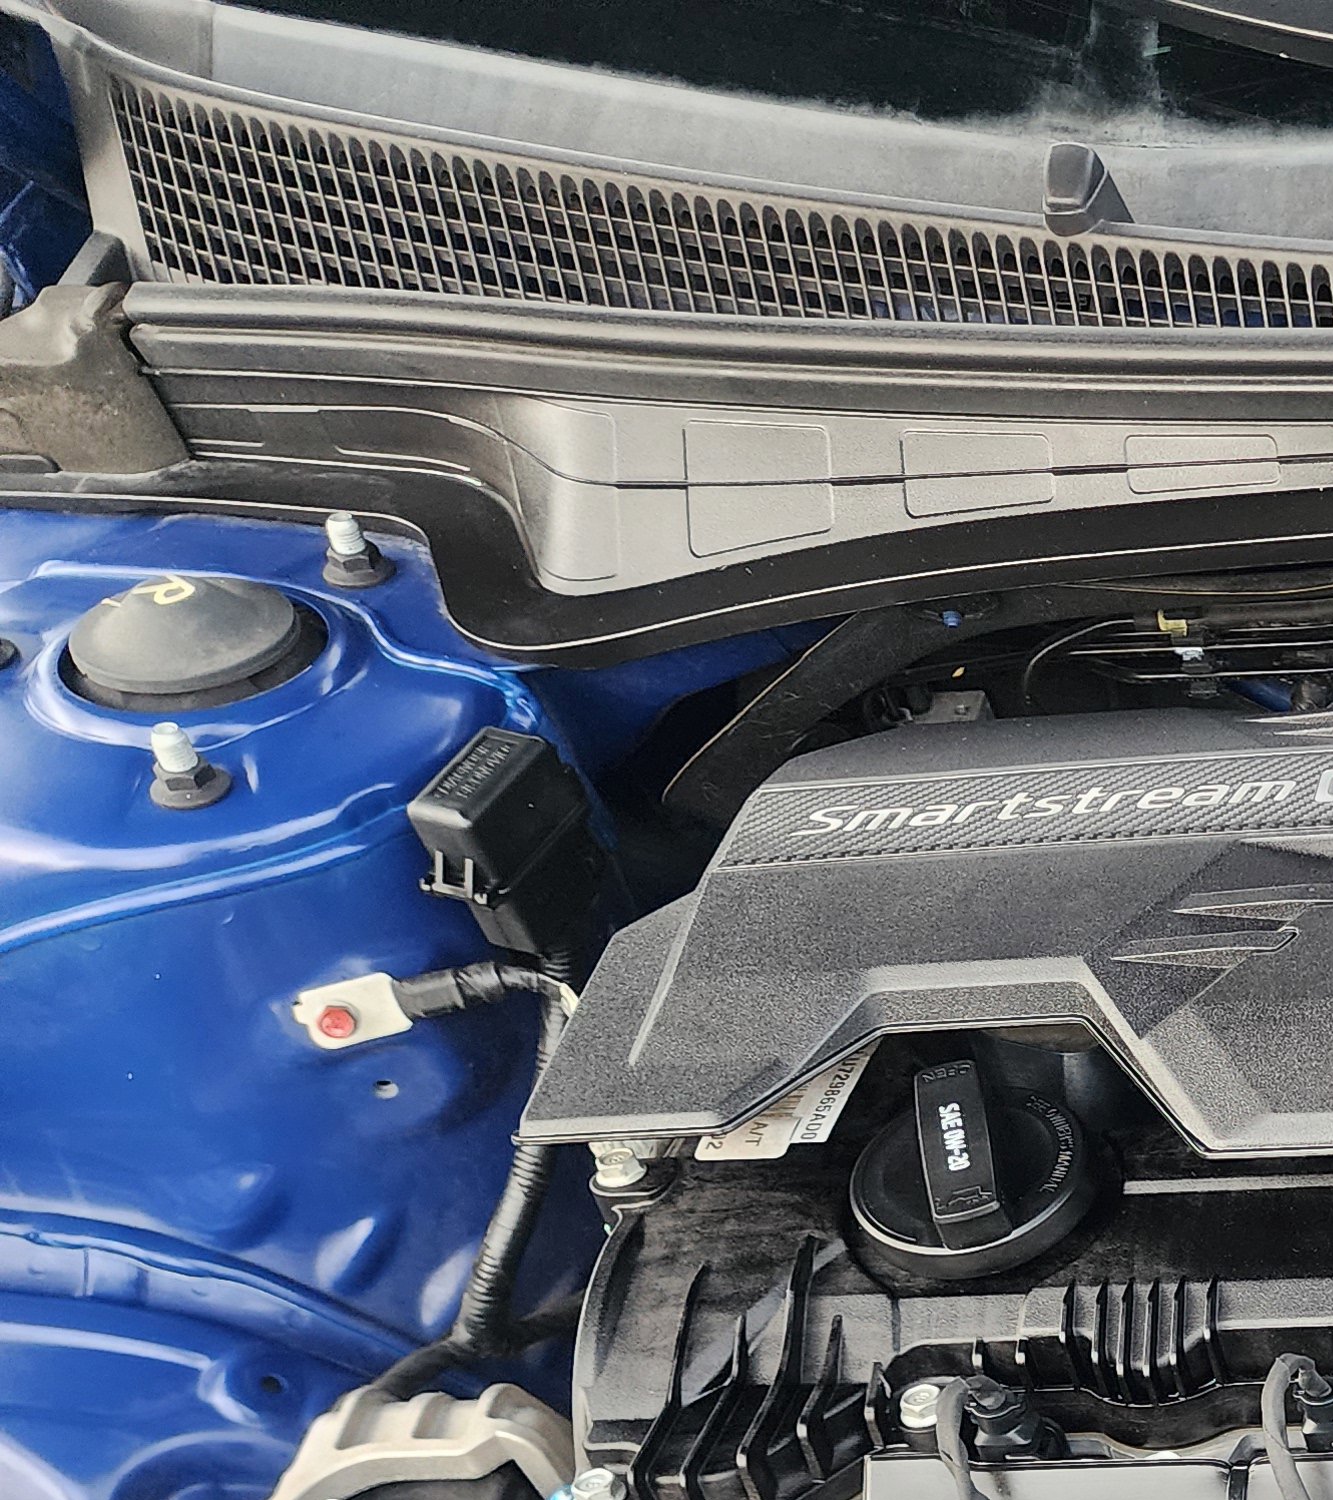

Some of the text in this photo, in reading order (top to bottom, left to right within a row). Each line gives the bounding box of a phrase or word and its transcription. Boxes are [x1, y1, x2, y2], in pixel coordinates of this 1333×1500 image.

[789, 778, 1297, 838] Smartstream
[744, 1121, 770, 1147] A/T
[937, 1101, 972, 1173] SAE 0W-20
[1039, 1150, 1074, 1193] MANUAL
